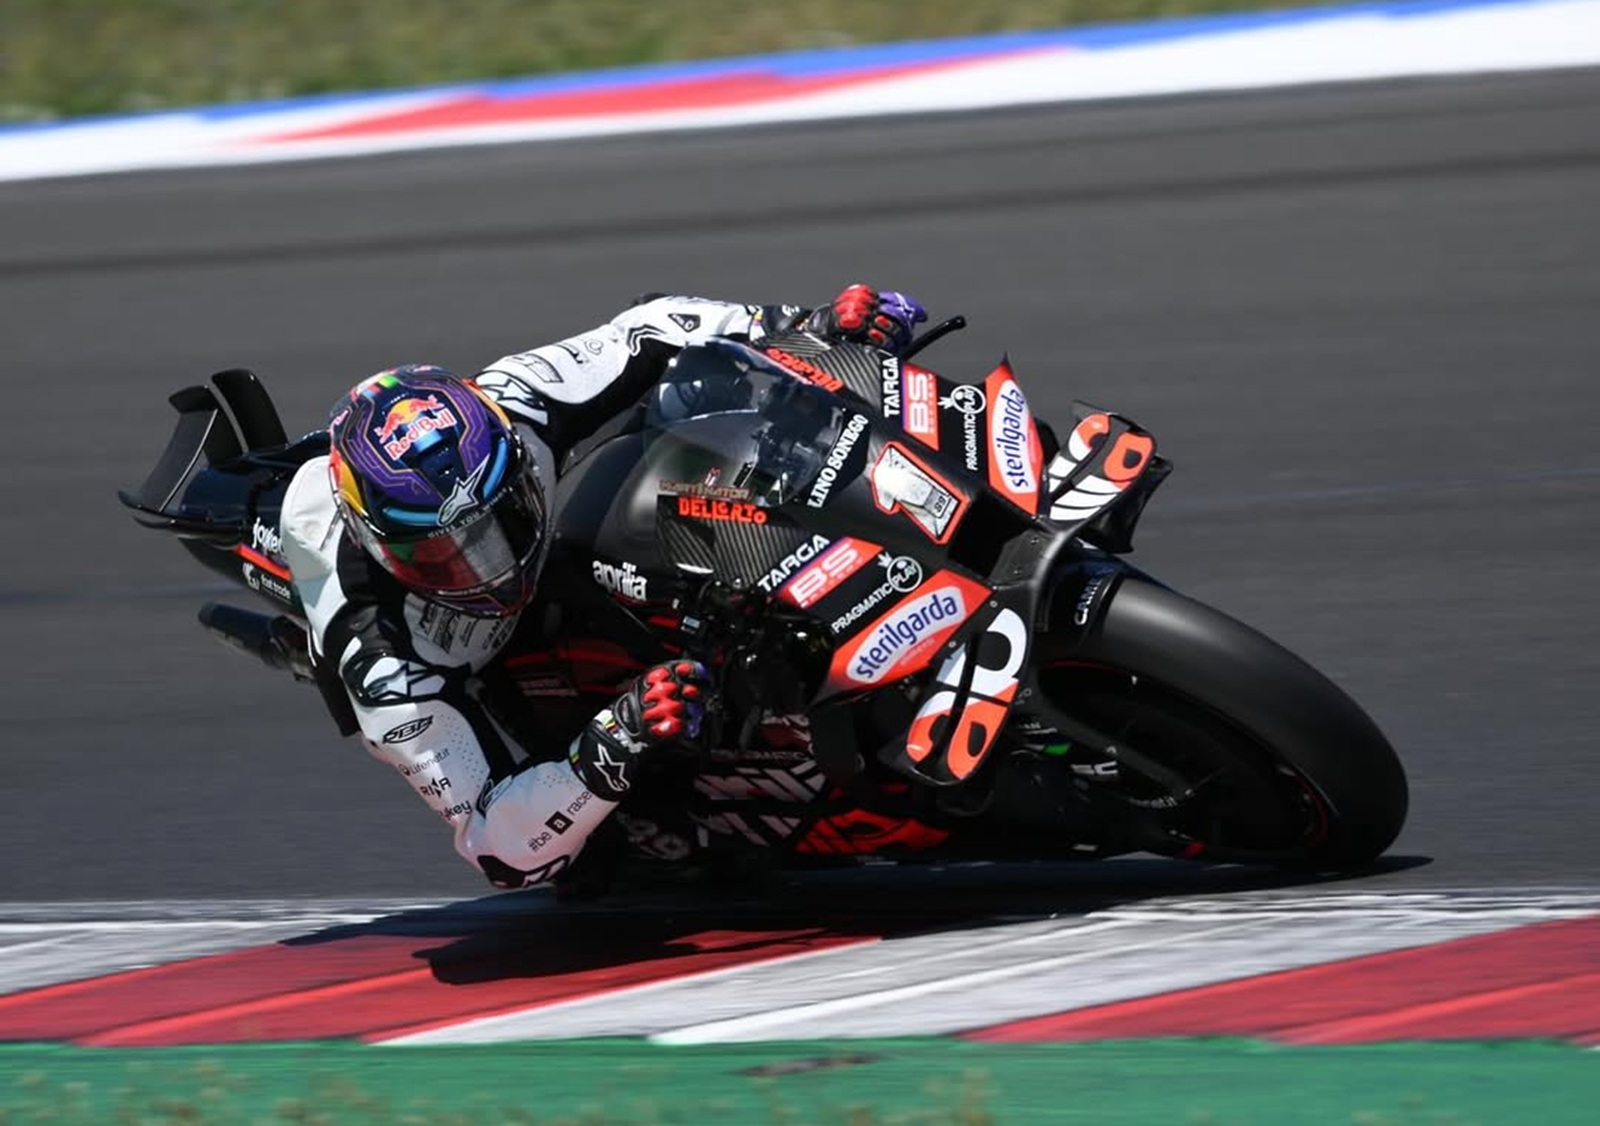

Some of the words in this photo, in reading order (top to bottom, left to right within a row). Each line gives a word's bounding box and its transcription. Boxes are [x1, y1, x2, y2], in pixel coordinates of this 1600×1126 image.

[883, 356, 900, 418] TARGA
[908, 373, 930, 434] BS
[384, 422, 421, 460] Red
[415, 408, 457, 435] Bull
[807, 464, 837, 508] LINO
[827, 413, 869, 470] SONEGO
[963, 412, 979, 470] PRAGMATIC
[996, 387, 1028, 488] sterilgarda
[871, 441, 969, 544] 1
[592, 560, 648, 601] aprilia
[757, 534, 830, 592] TARGA
[788, 543, 860, 607] BS
[831, 584, 893, 634] PRAGMATIC
[891, 563, 918, 590] PLAY
[856, 593, 958, 679] sterilgarda
[529, 829, 553, 853] #be
